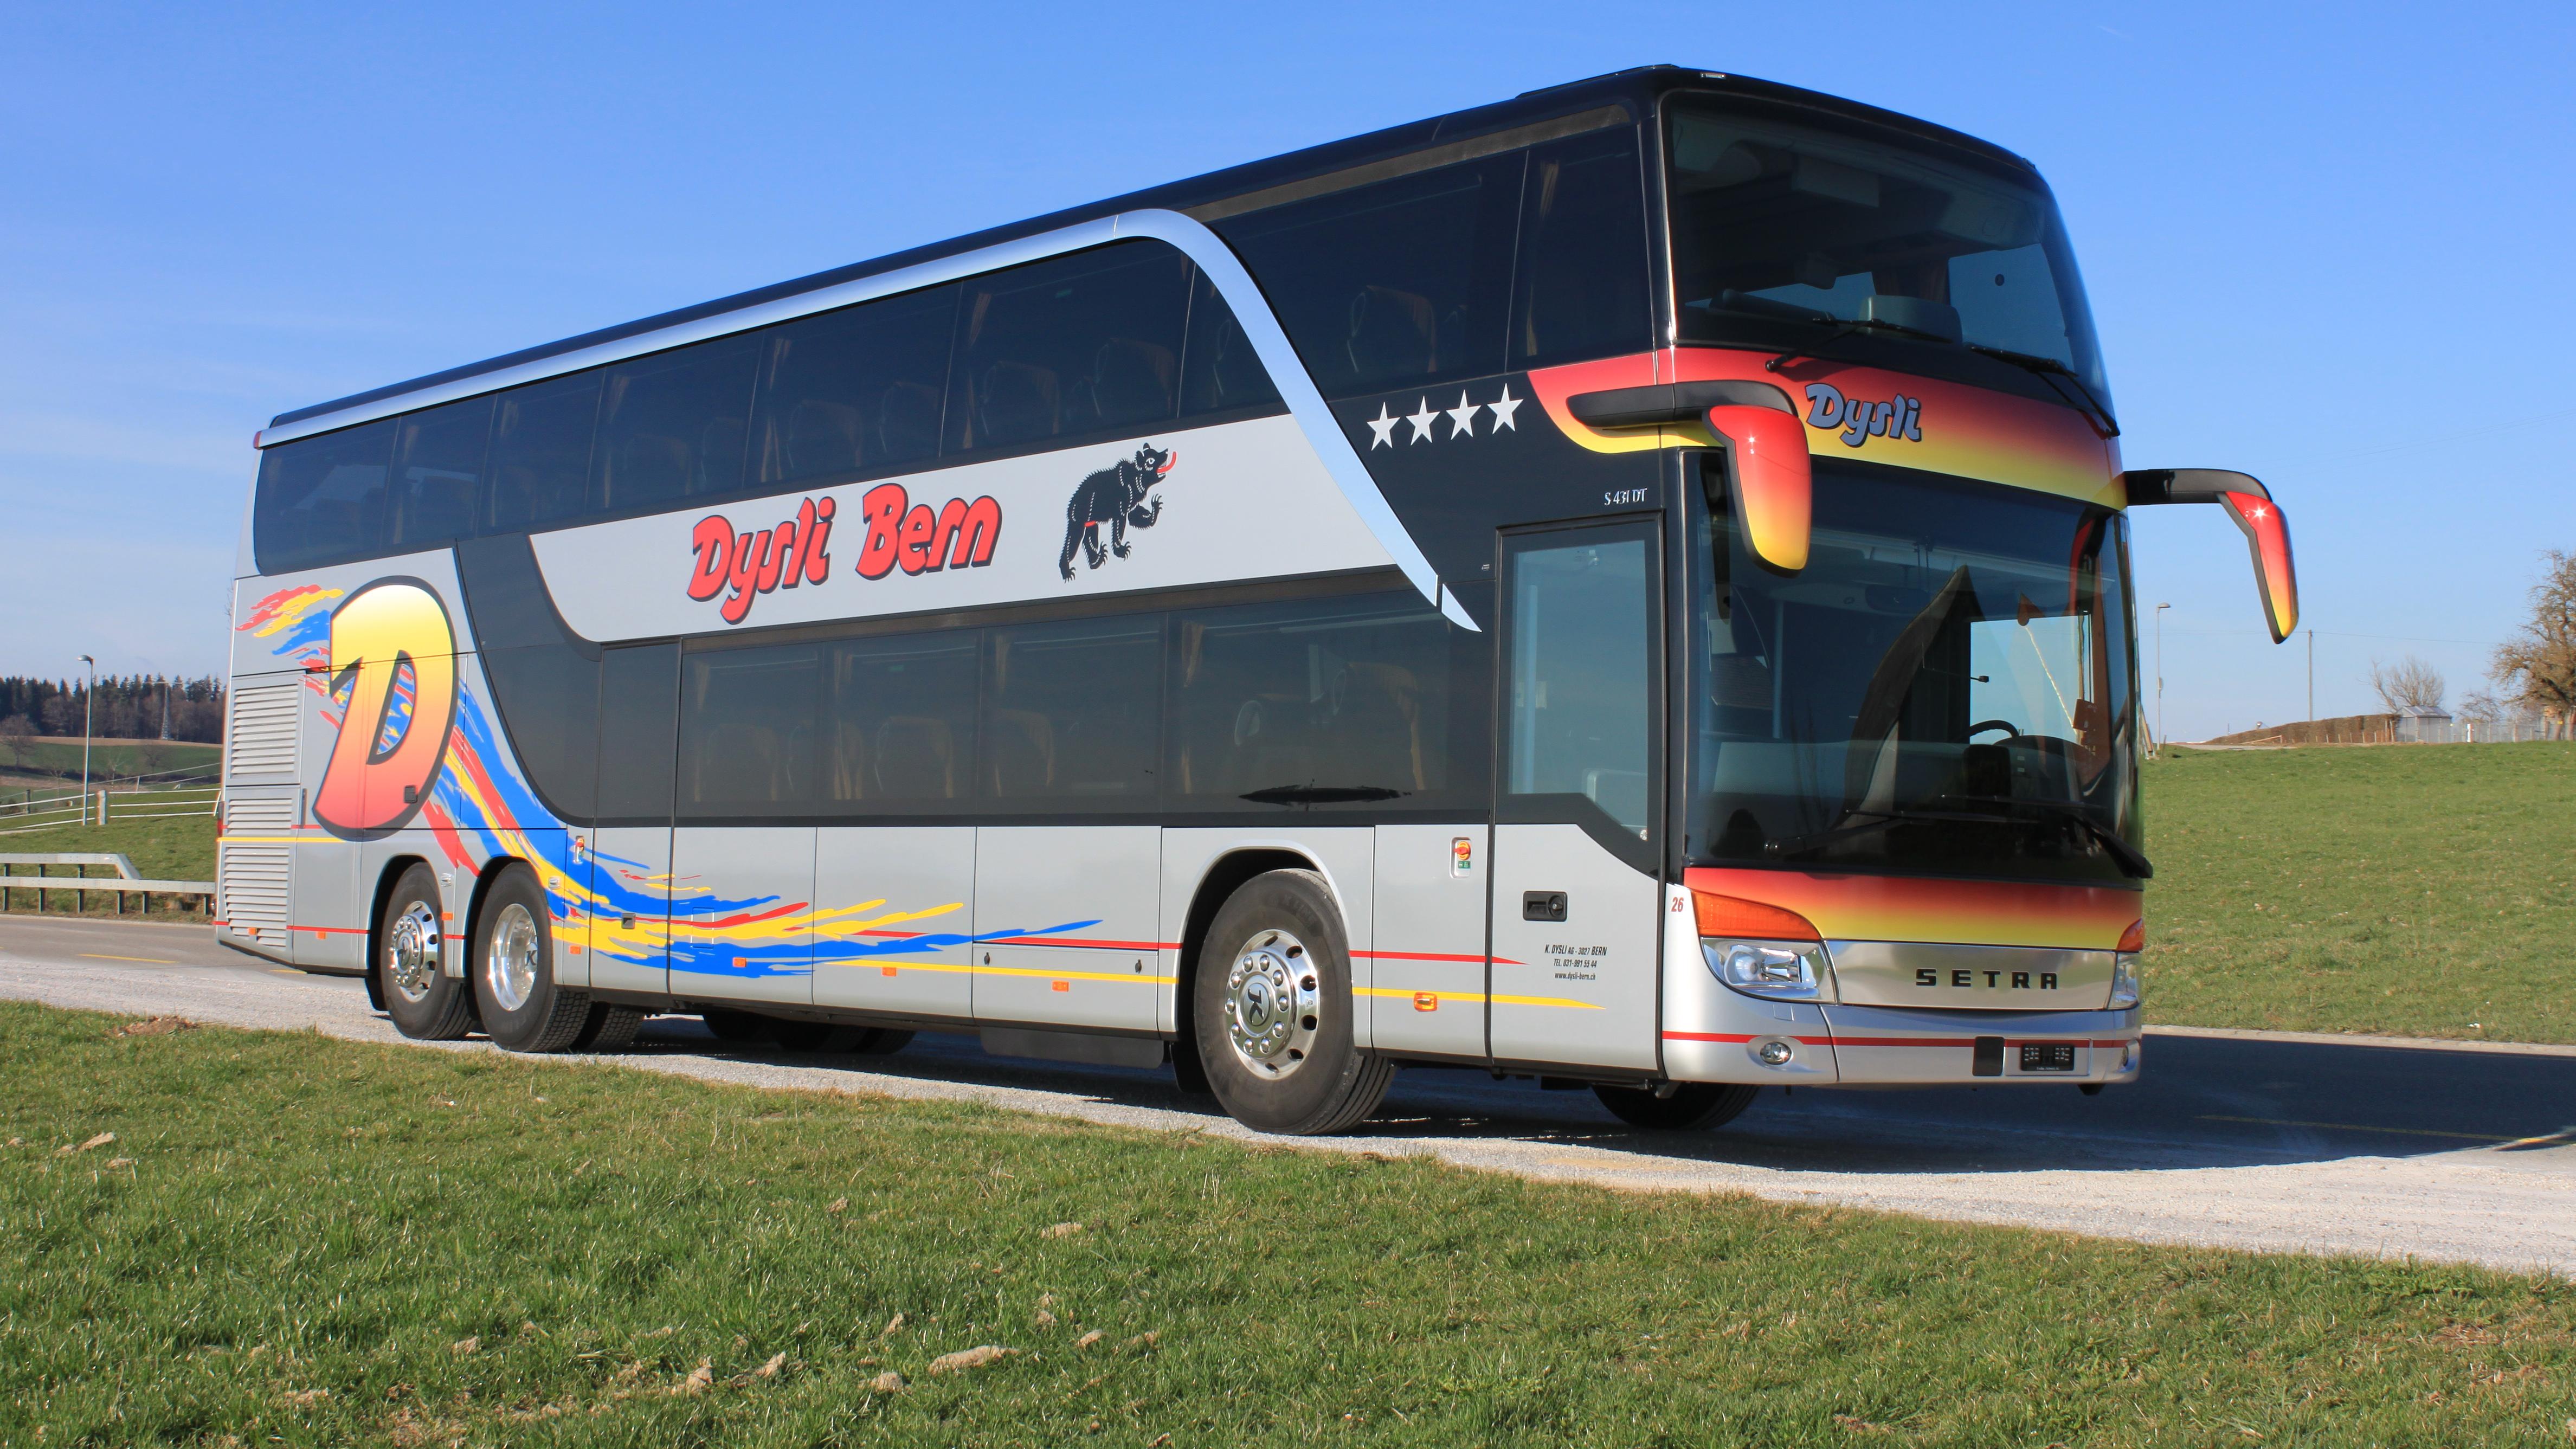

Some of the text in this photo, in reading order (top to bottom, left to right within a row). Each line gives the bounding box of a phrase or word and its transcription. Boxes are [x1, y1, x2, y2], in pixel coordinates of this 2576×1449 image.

[1805, 383, 1922, 448] Dysli
[1604, 488, 1648, 505] S 431 DT
[687, 482, 1002, 624] Dysli Bern
[312, 575, 459, 841] D
[1671, 897, 1684, 912] 26
[1544, 944, 1550, 954] K.
[1551, 944, 1567, 955] DYSLI
[1567, 946, 1575, 955] AG
[1578, 947, 1590, 955] 3027
[1591, 946, 1607, 956] BERN
[1554, 958, 1562, 967] TEL.
[1563, 959, 1583, 968] 031-991
[1590, 960, 1598, 968] 44
[1554, 971, 1596, 981] www.dysli-bern.ch
[1916, 968, 2057, 990] SETRA
